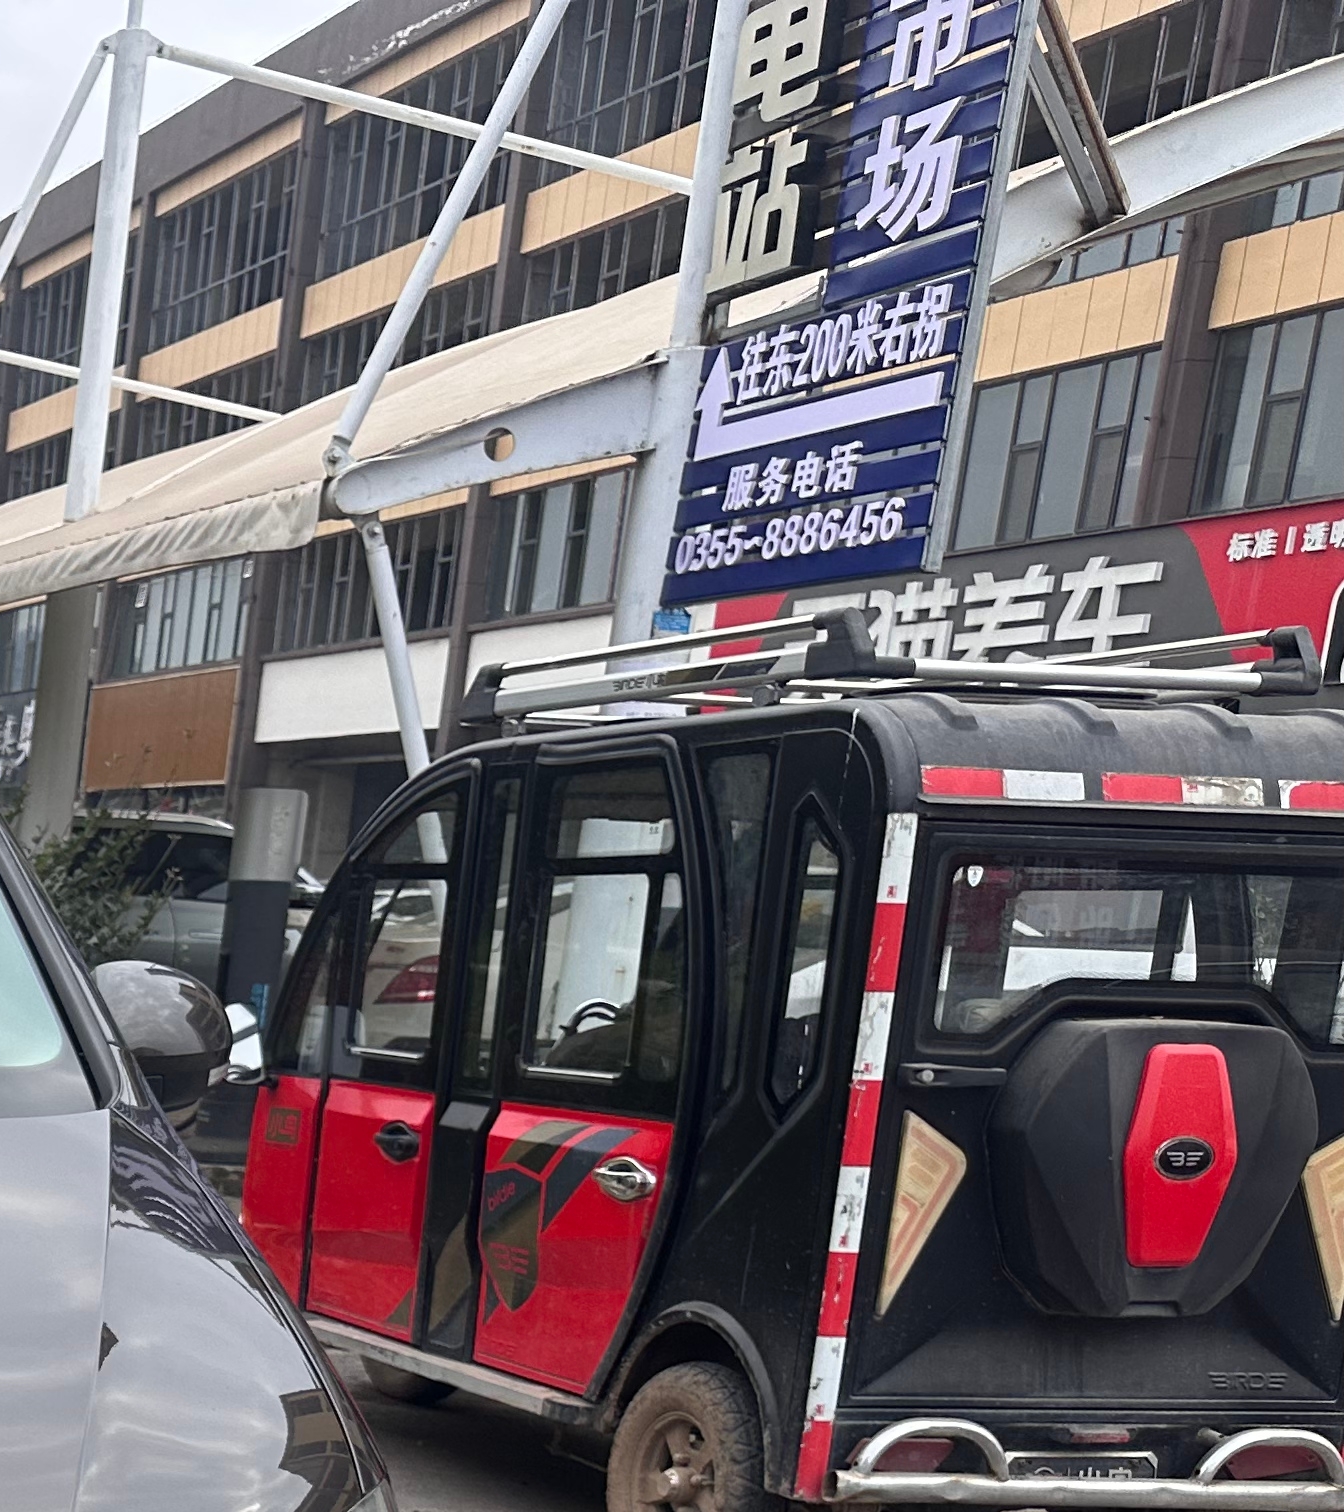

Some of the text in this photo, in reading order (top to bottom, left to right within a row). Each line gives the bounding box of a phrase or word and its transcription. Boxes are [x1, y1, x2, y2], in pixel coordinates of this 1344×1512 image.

[706, 0, 825, 294] 电站
[856, 0, 974, 242] 市场
[722, 440, 863, 512] 服务电话
[1226, 528, 1279, 563] 标准
